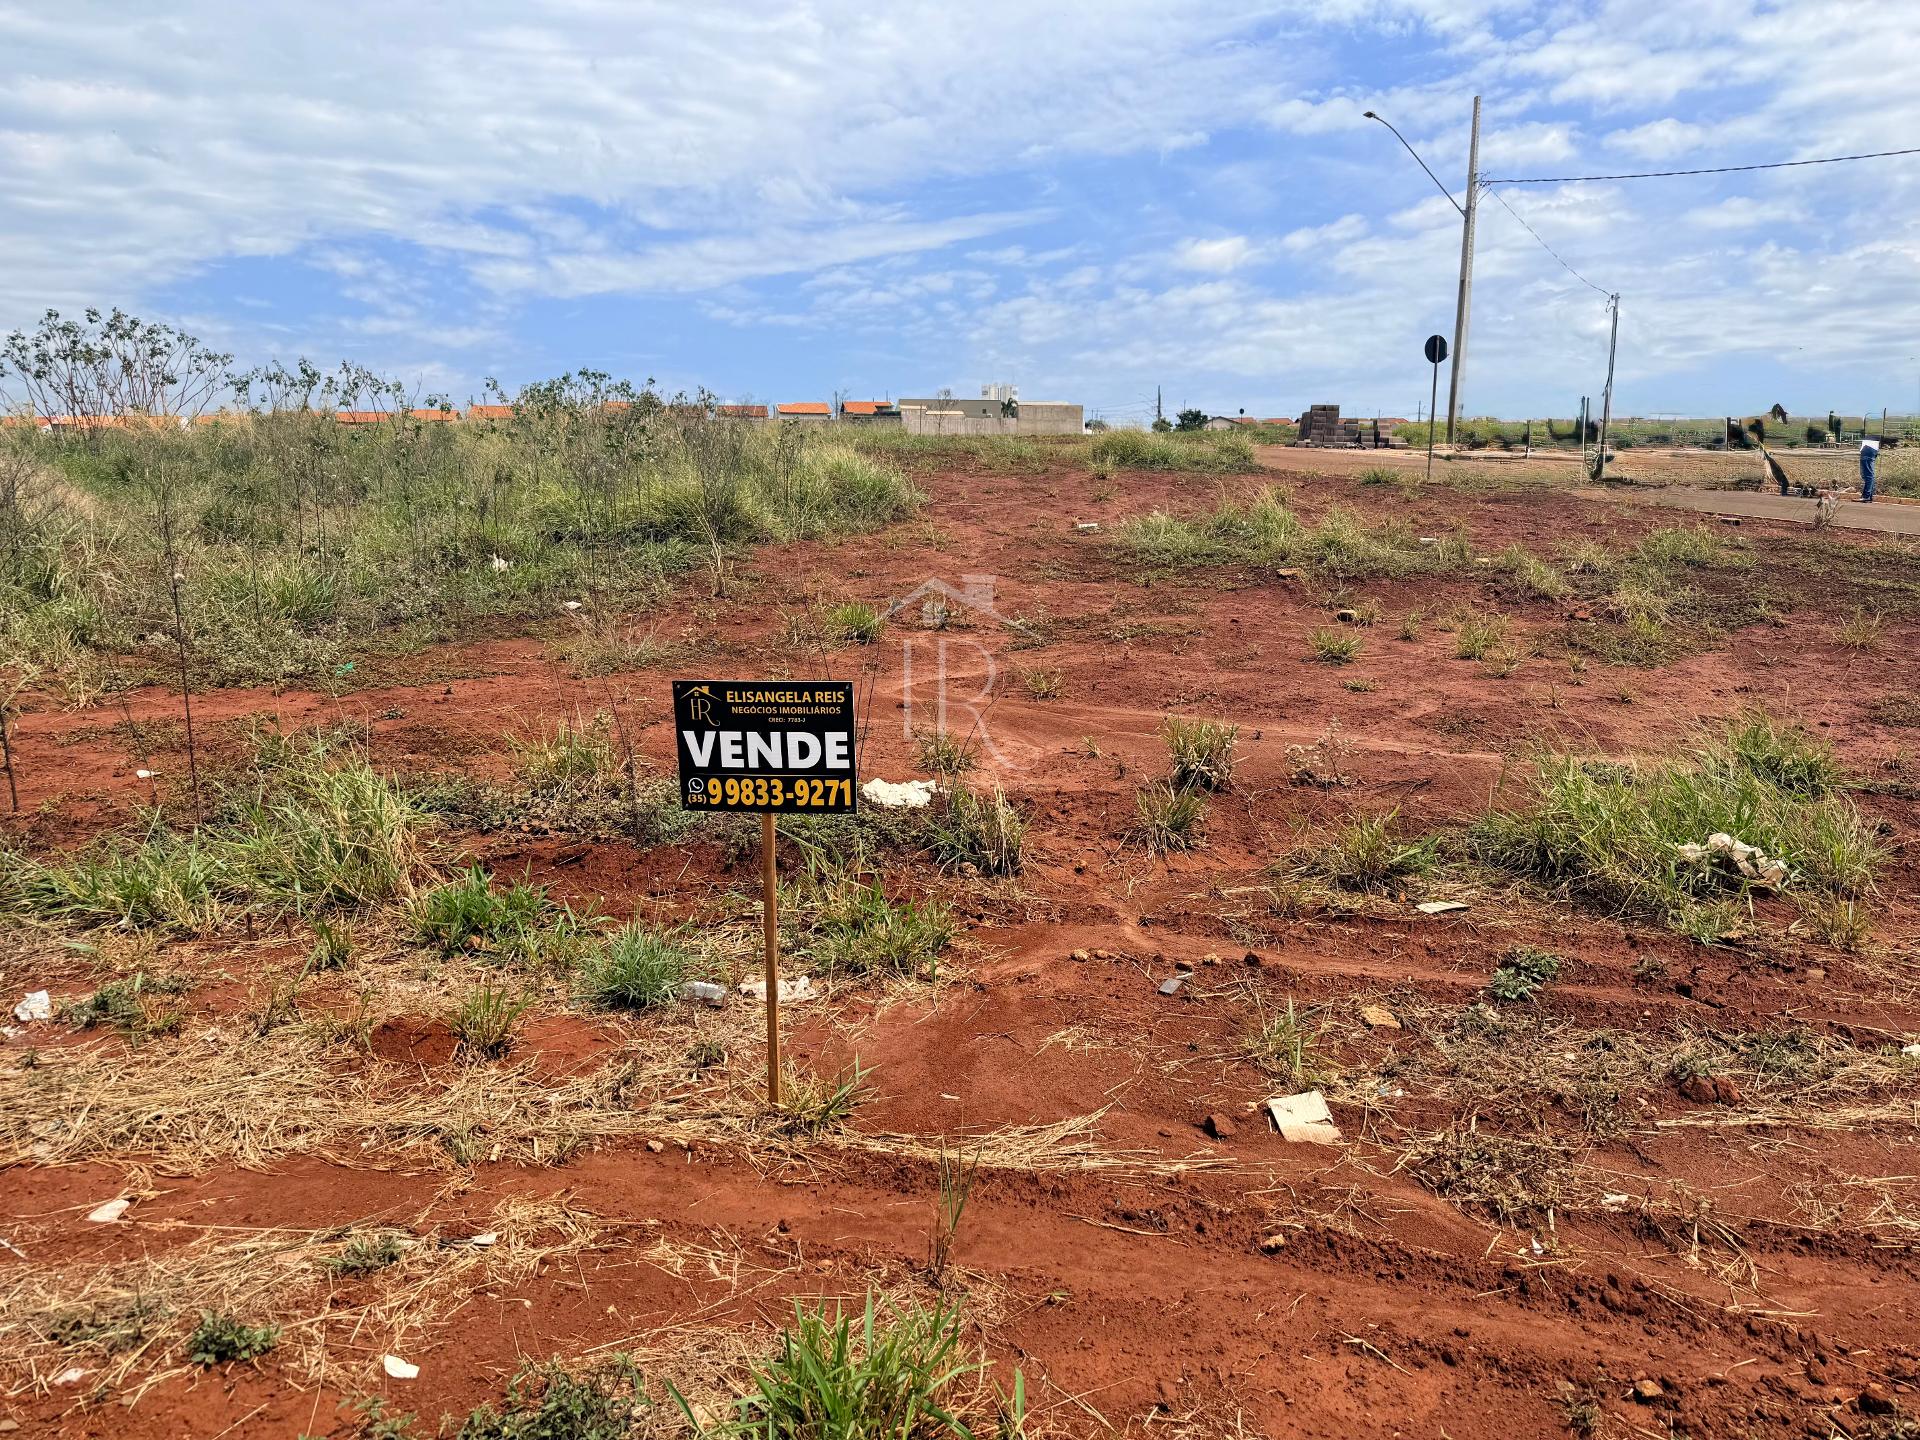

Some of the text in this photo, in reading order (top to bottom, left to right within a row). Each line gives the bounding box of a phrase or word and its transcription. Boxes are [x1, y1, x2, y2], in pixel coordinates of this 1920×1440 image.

[726, 691, 845, 704] ELISANGELA REIS
[731, 705, 841, 715] NEGÓCIOS IMOBILIÁRIOS
[682, 730, 850, 769] VENDE
[687, 793, 707, 805] (35)
